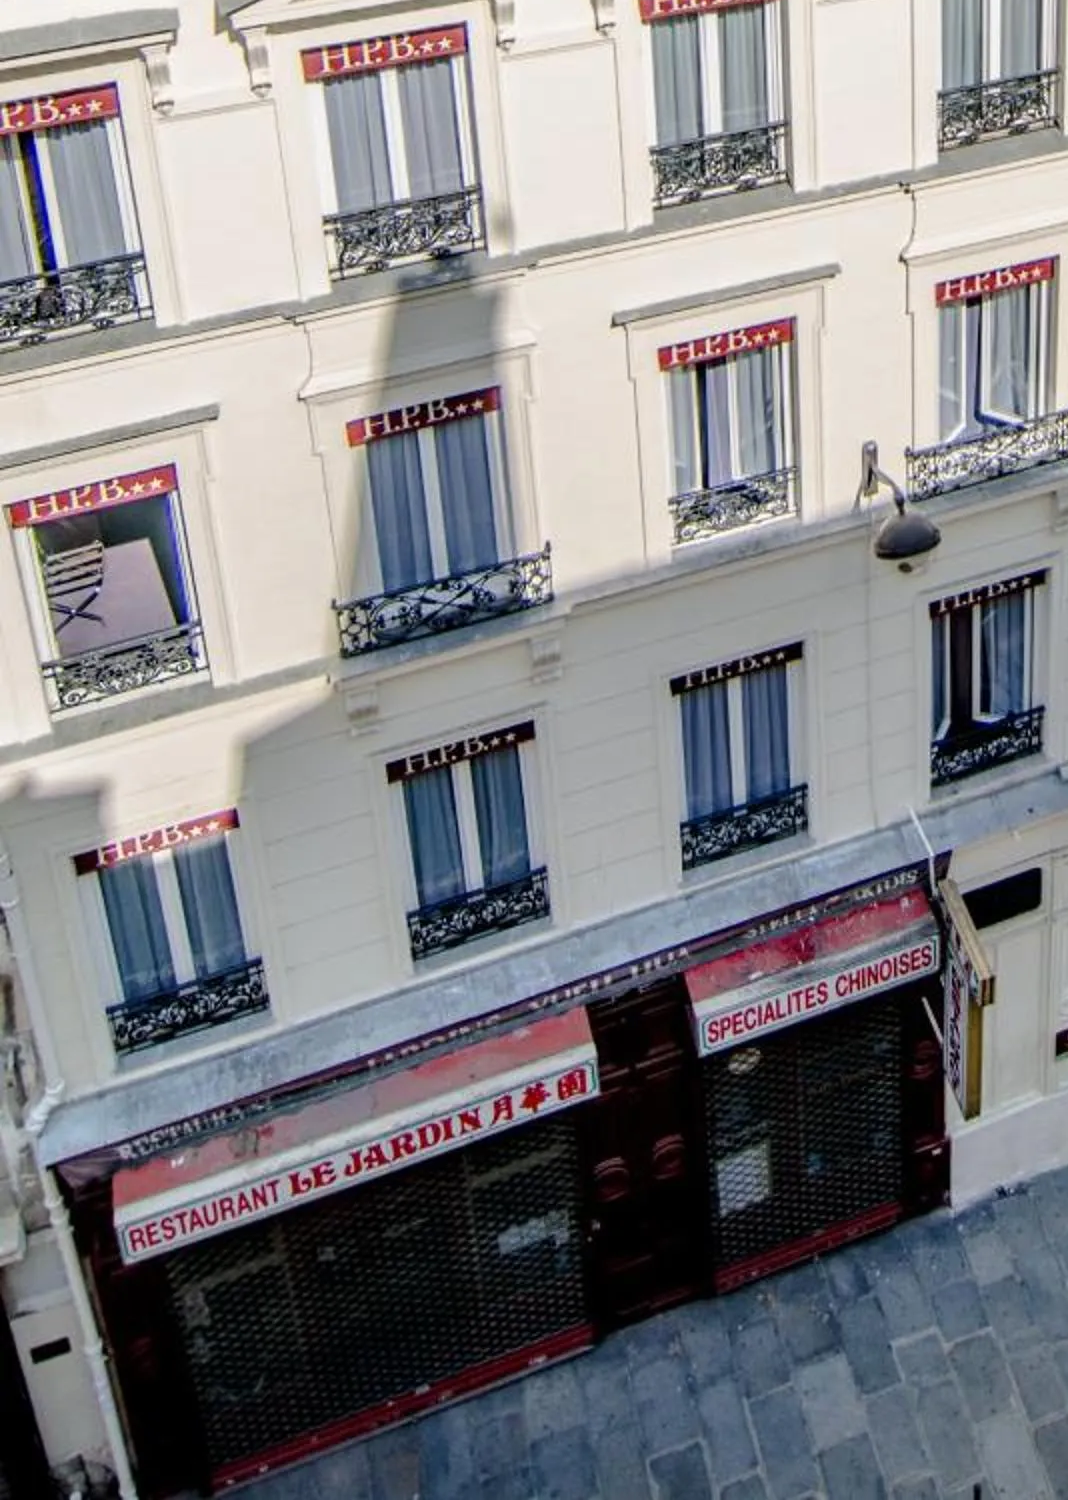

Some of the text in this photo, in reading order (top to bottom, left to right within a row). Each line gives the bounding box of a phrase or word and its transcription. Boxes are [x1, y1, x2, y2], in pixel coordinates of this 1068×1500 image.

[320, 37, 420, 72] H.P.B.
[671, 329, 752, 364] H.P.B.
[363, 399, 454, 439] H.P.B.
[29, 480, 130, 520] H.P.B.
[706, 980, 829, 1043] SPECIALITES
[835, 945, 933, 997] CHINOISES
[129, 1105, 482, 1252] RESTAURANT LE JARDIN
